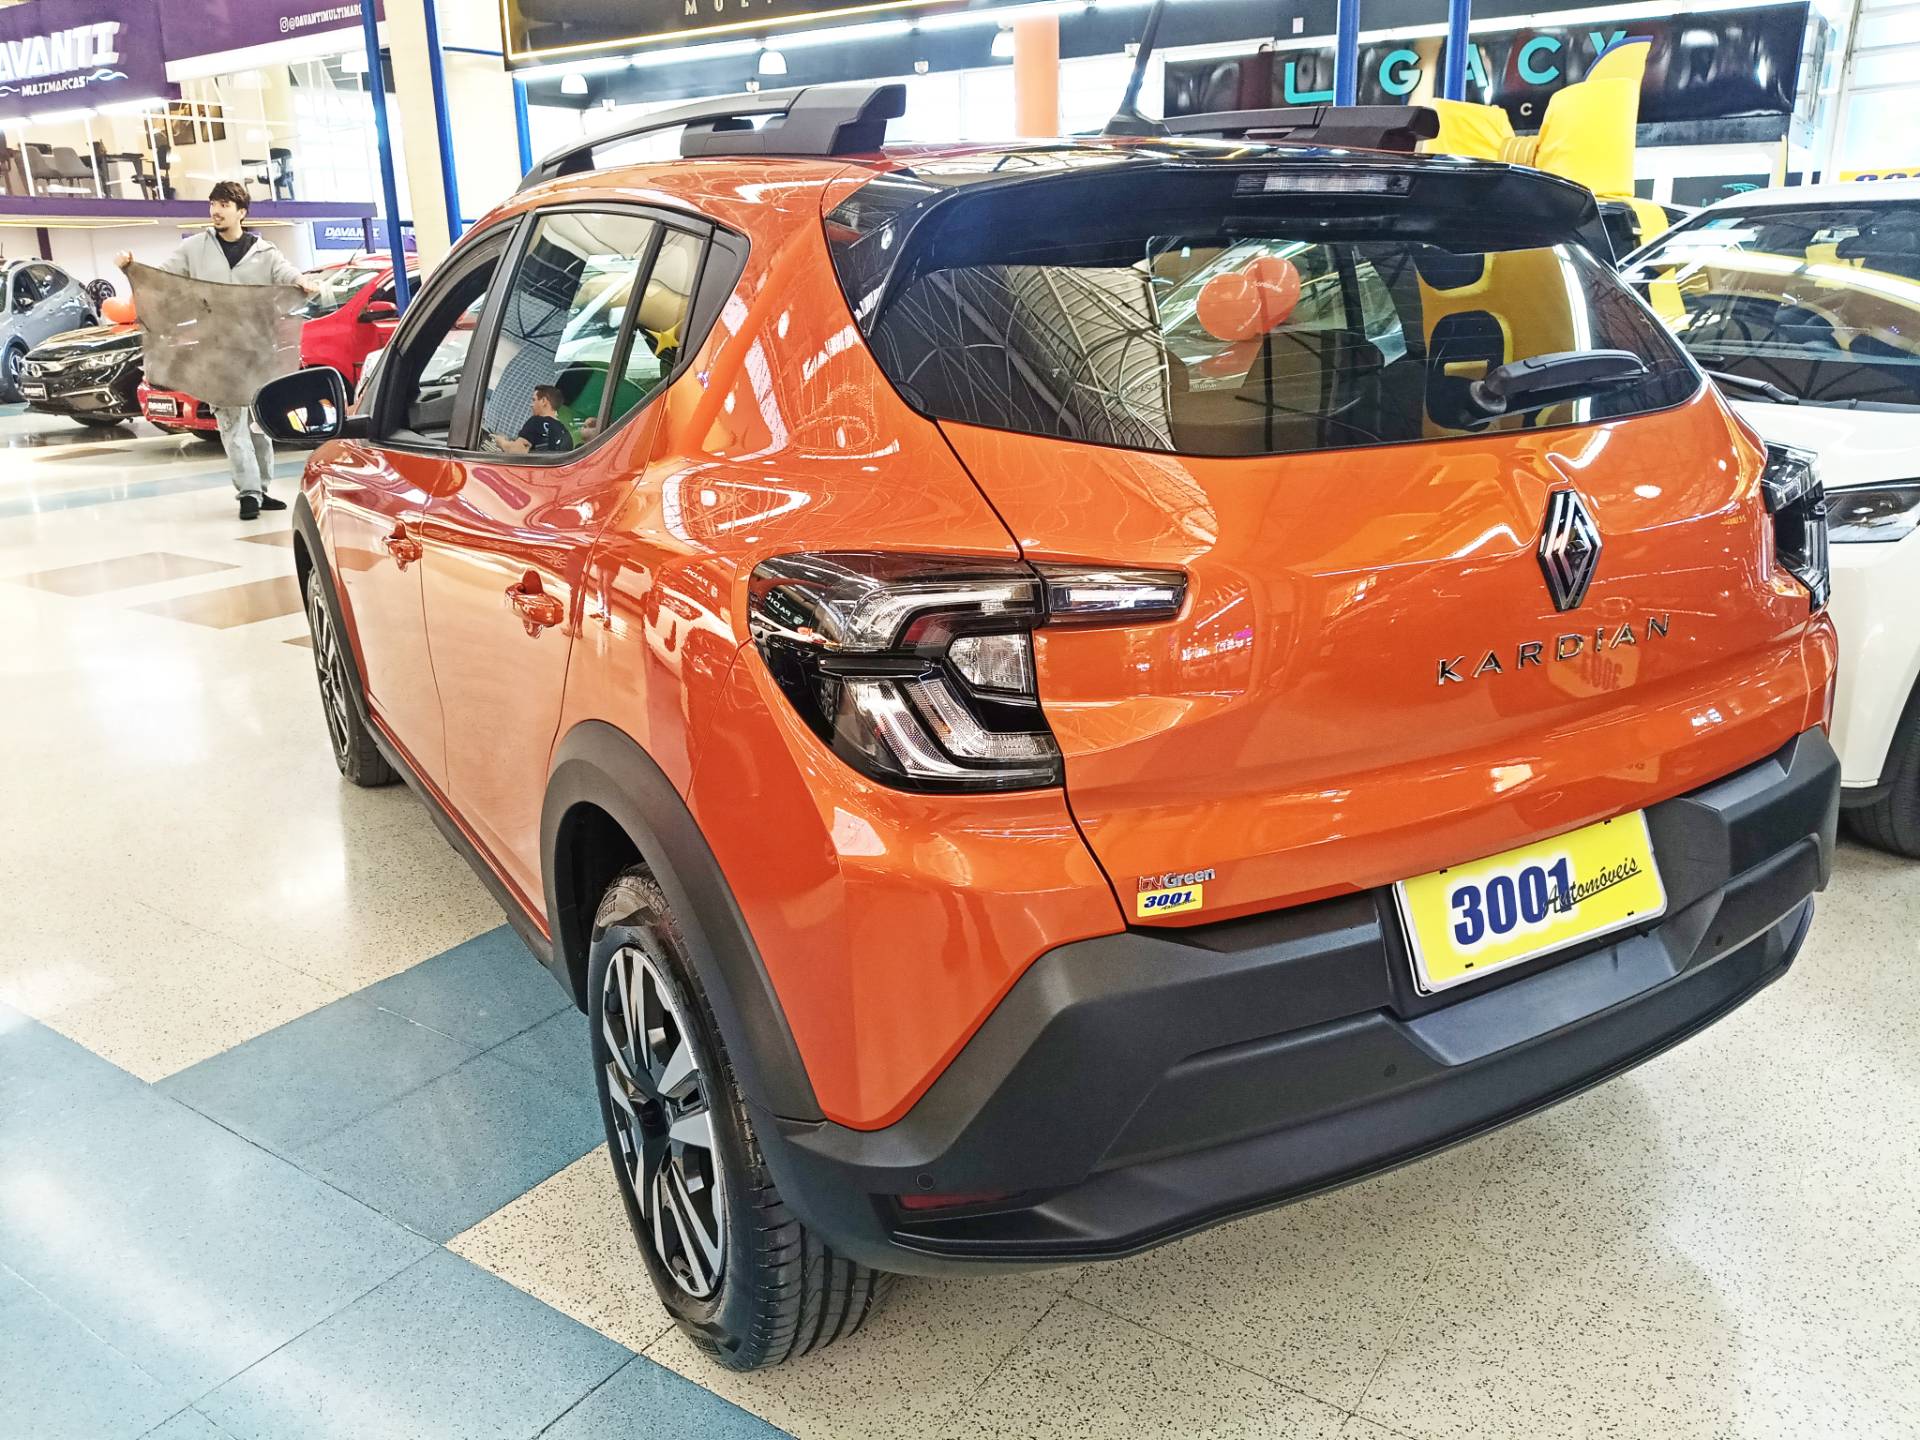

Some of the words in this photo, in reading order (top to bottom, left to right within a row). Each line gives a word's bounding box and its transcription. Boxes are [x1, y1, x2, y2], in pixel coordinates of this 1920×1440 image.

[21, 75, 86, 97] MULTIMARCAS
[325, 226, 380, 237] DAVANI
[1437, 613, 1670, 685] KARDIAN
[1143, 890, 1193, 908] 3001
[1451, 856, 1573, 946] 3001
[1543, 855, 1642, 919] Automóveis
